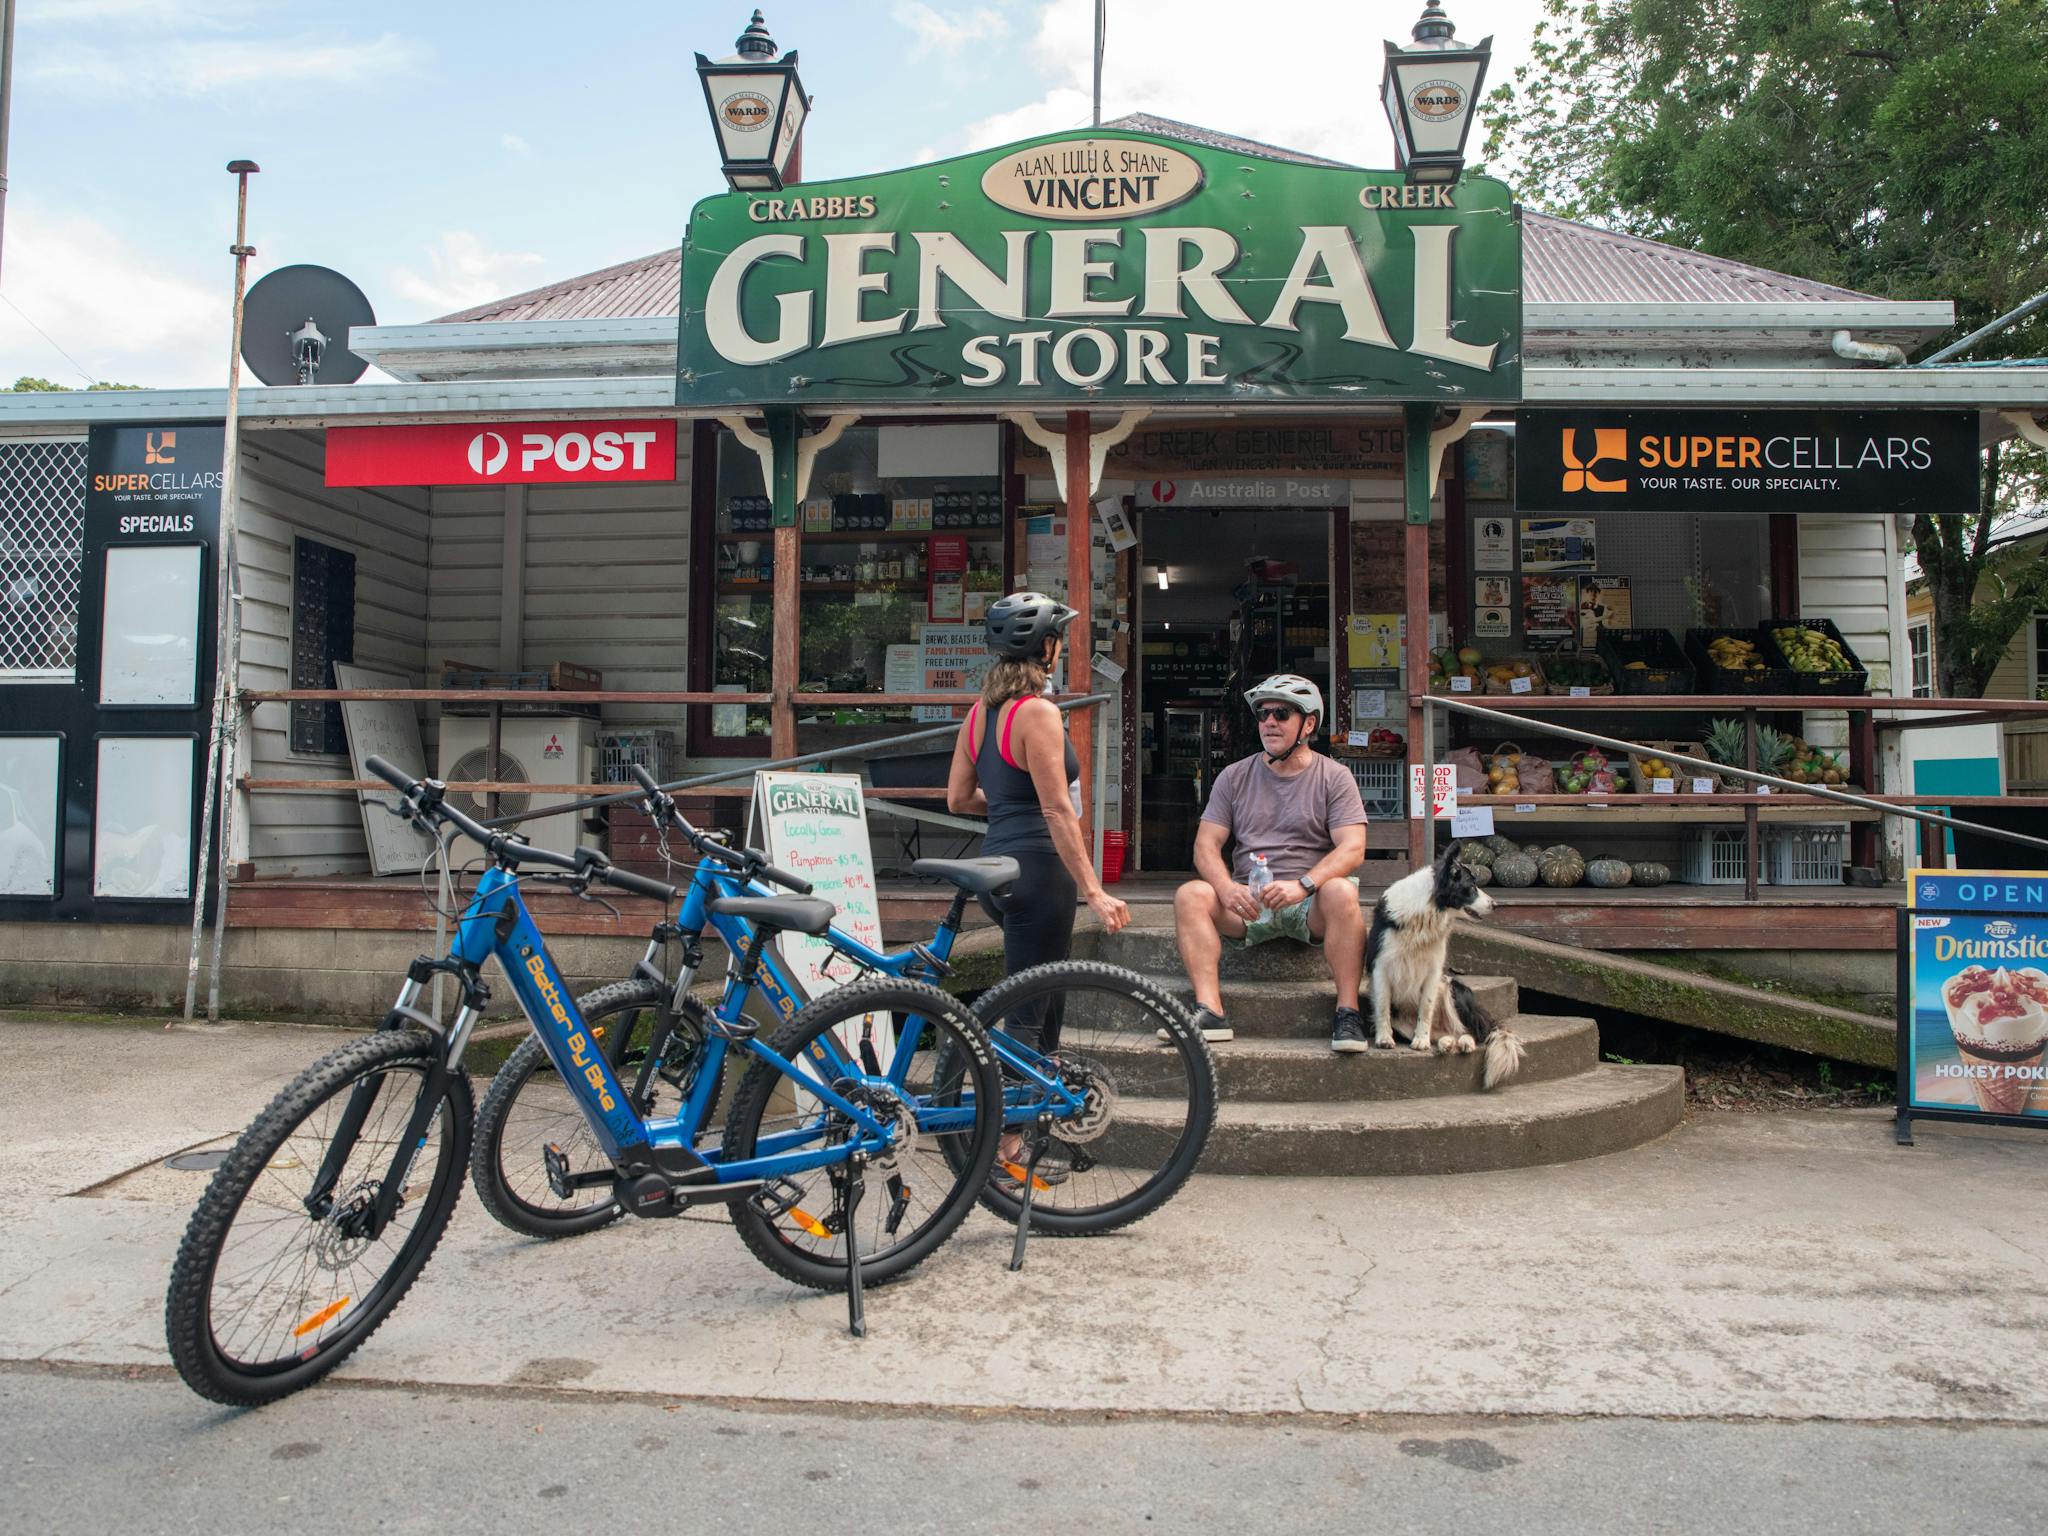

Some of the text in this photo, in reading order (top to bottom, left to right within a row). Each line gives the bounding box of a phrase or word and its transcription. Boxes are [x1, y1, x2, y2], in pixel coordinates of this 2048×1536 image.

[1417, 96, 1459, 105] WARDS
[728, 108, 767, 116] WARDS
[1014, 150, 1169, 178] ALAN, LULU & SHANE
[1024, 176, 1160, 210] VINCENT
[1359, 184, 1456, 209] CREEK
[748, 196, 877, 223] CRABBES
[704, 223, 1499, 372] GENERAL
[960, 328, 1228, 388] STORE
[523, 432, 657, 472] POST
[1144, 431, 1218, 456] CREEK
[1236, 430, 1341, 455] GENERAL
[1359, 429, 1404, 453] STO
[1638, 435, 1930, 470] SUPERCELLARS
[95, 472, 224, 492] SUPERCELLARS
[1190, 481, 1330, 498] Australia Post
[1640, 478, 1840, 491] YOUR TASTE. OUR SPECIALTY.
[170, 492, 204, 500] SPECIALTY.
[120, 515, 194, 533] SPECIALS
[951, 634, 970, 644] BEATS
[956, 648, 987, 656] FRIENDL
[925, 658, 968, 667] FREE ENTRY
[933, 680, 958, 688] MUSIC
[936, 671, 956, 679] LIVE
[1416, 768, 1450, 776] FLOD
[773, 791, 858, 816] GENERAL
[1421, 793, 1446, 801] 217
[1958, 884, 2042, 903] OPEN
[1984, 924, 2016, 936] Peters
[1936, 935, 2048, 960] Drumstic
[1131, 990, 1188, 1040] MAXXIS
[526, 955, 616, 1112] Better By Bike
[942, 1012, 989, 1066] MAXXIS
[1936, 1064, 2048, 1080] HOKEY POK
